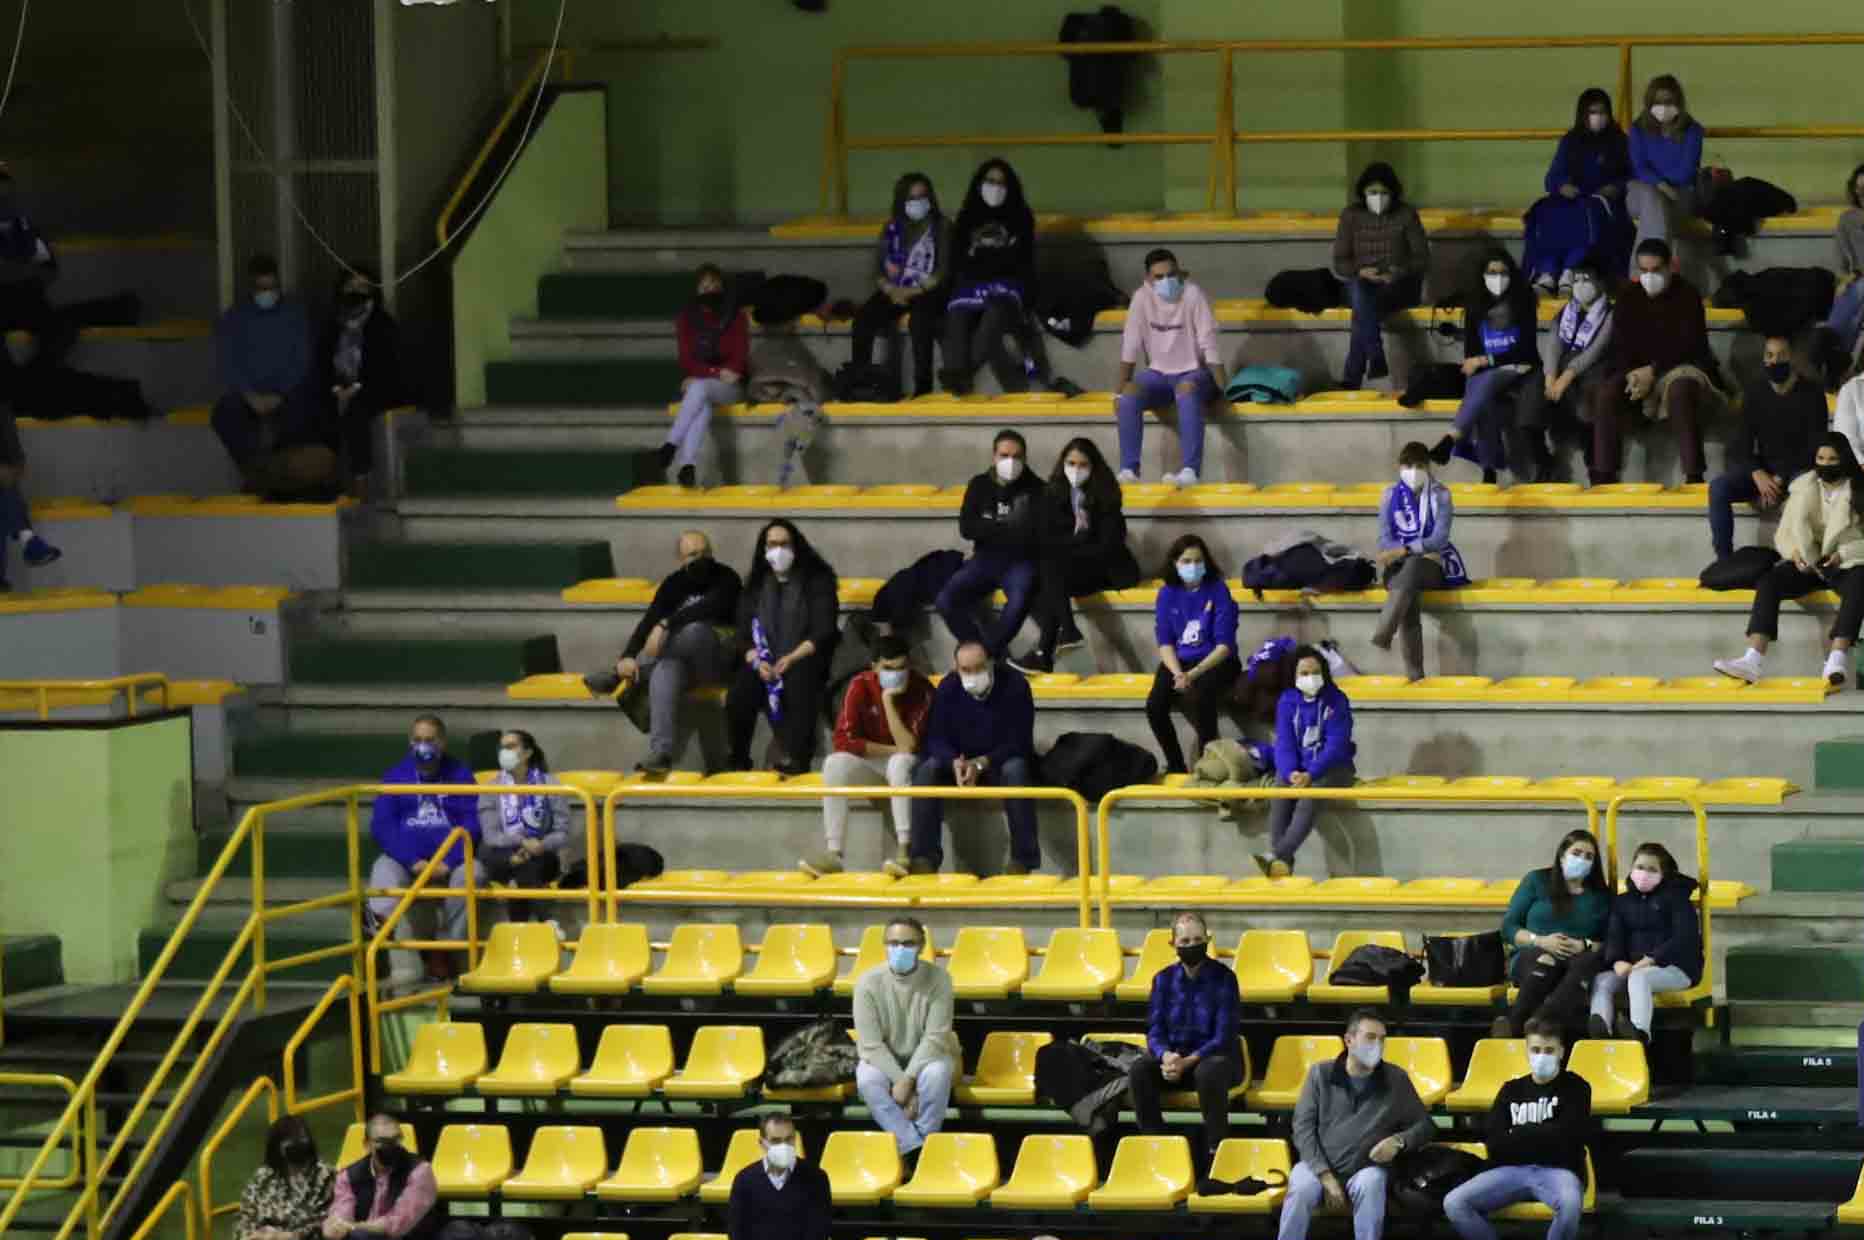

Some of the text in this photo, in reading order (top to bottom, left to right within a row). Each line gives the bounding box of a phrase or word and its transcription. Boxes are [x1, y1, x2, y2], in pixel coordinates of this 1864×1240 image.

[1803, 1057, 1824, 1066] FILA
[1747, 1110, 1769, 1119] FILA
[1693, 1215, 1715, 1225] FILA
